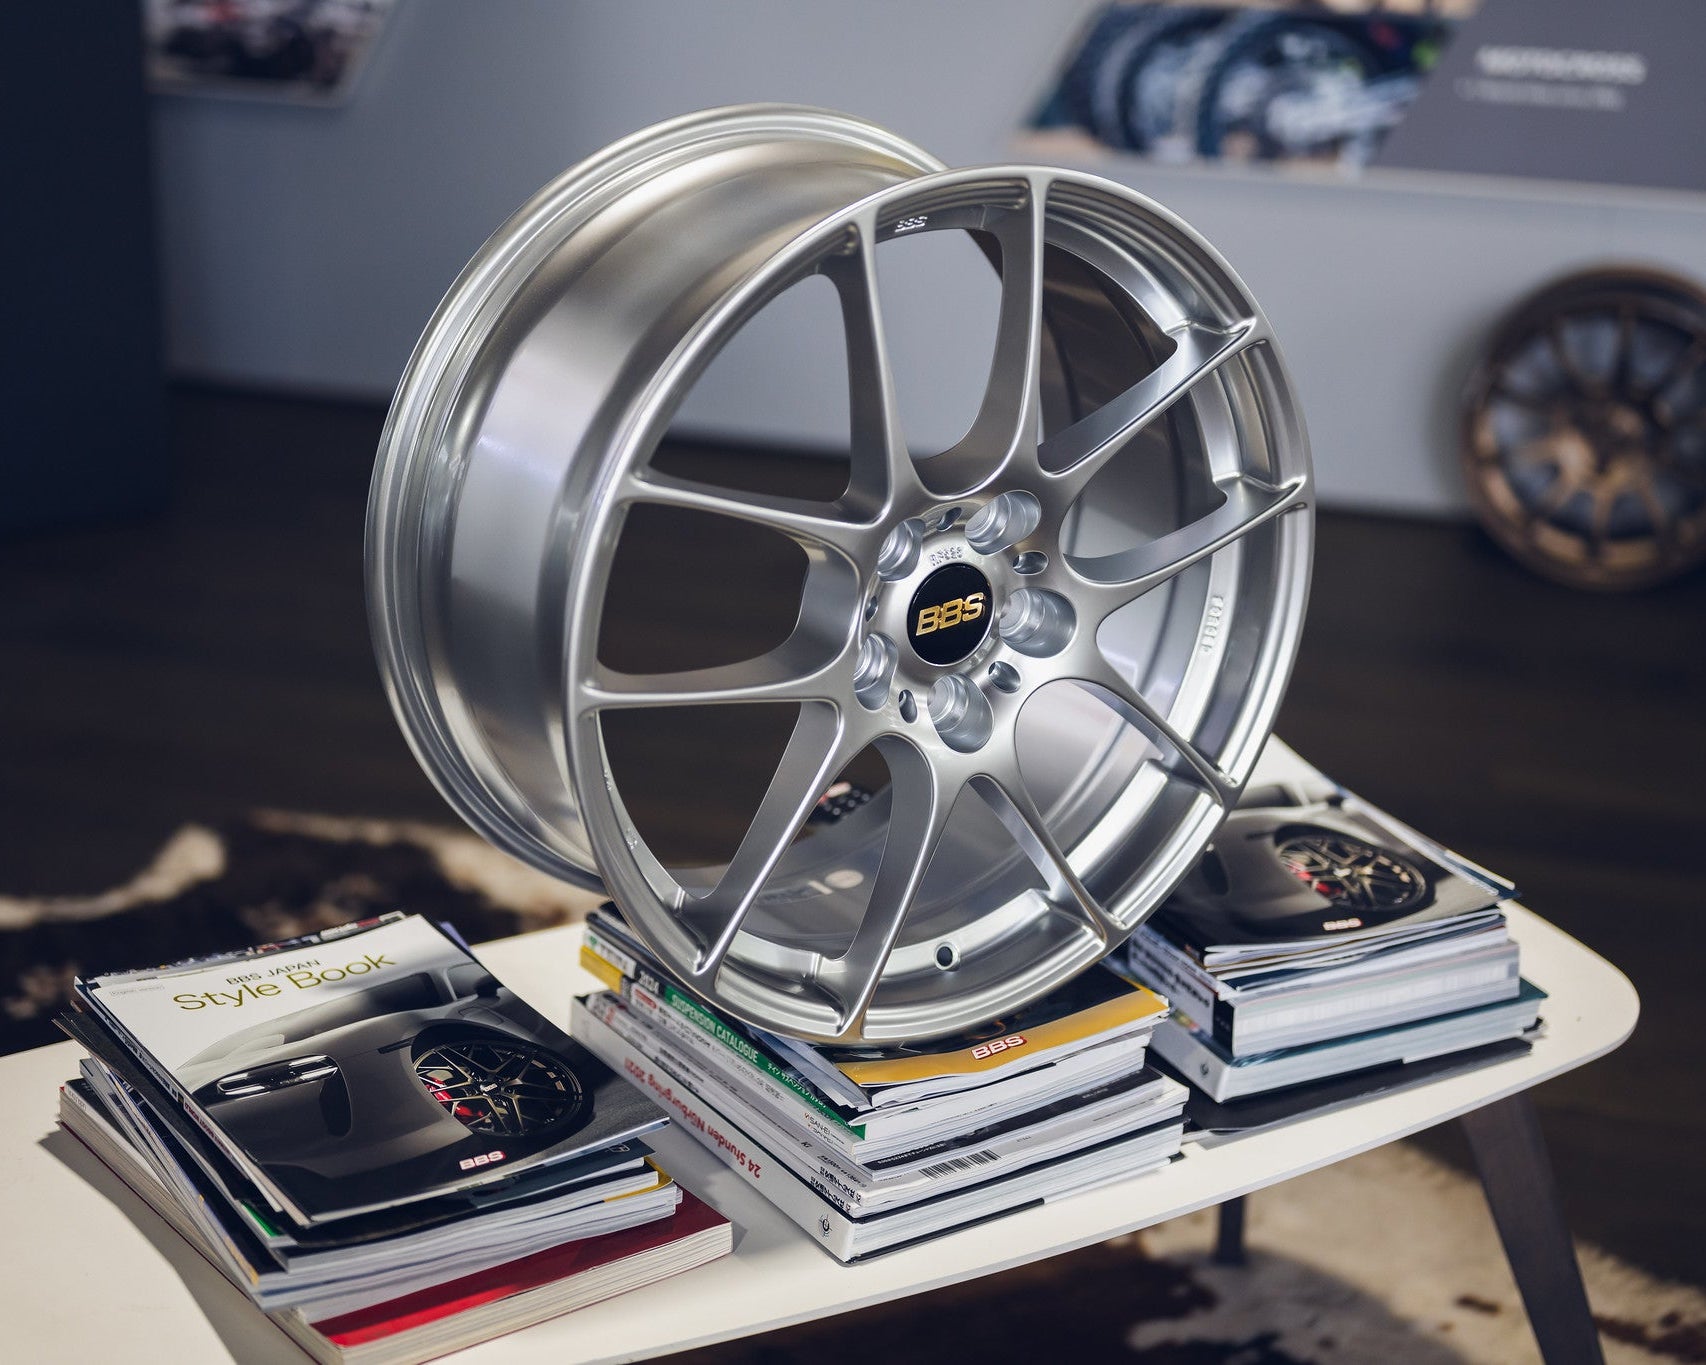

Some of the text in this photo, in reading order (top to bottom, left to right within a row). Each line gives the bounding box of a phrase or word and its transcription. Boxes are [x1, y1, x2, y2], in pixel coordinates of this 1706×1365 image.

[916, 592, 985, 636] BBS
[173, 954, 396, 1010] Style Book
[226, 959, 321, 985] BBS JAPAN
[671, 994, 717, 1034] SUSPENSION
[716, 1025, 759, 1063] CATALOGUE
[971, 1035, 1028, 1060] BBS
[459, 1150, 505, 1170] BBS
[707, 1125, 747, 1166] Stunden
[748, 1159, 761, 1178] 24
